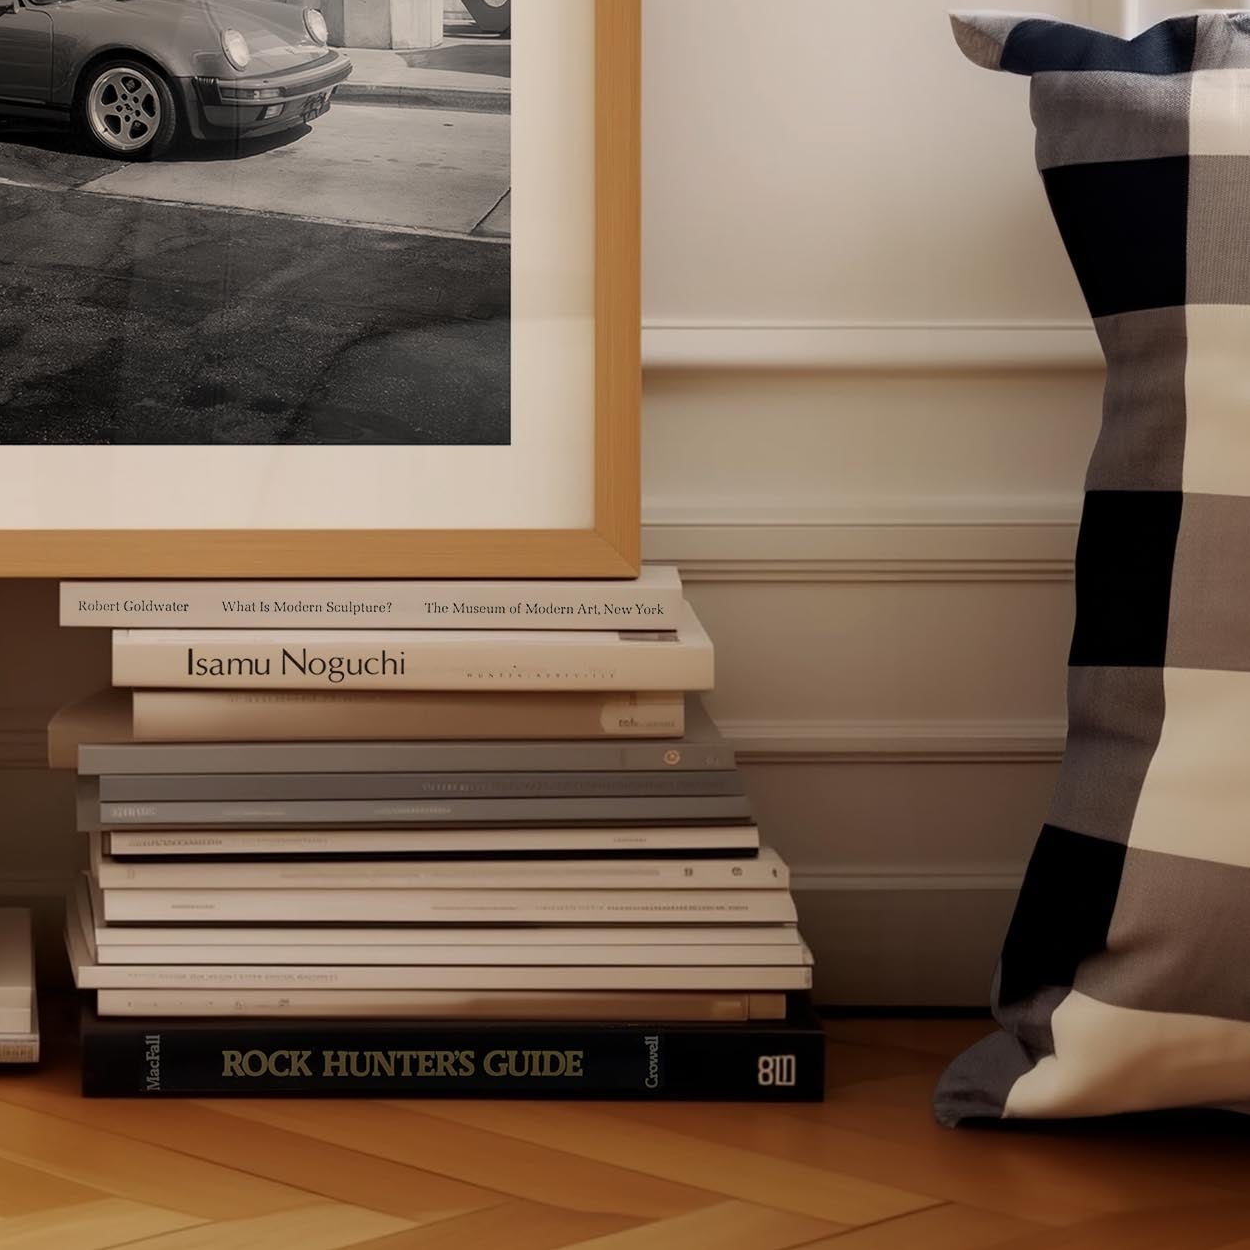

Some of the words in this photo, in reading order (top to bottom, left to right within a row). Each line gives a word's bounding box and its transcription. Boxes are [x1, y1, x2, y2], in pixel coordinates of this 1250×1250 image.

[78, 600, 119, 612] Robert
[123, 600, 190, 612] Goldwater
[222, 600, 255, 612] What
[260, 601, 270, 612] Is
[274, 601, 322, 612] Modern
[327, 601, 392, 616] Sculpture?
[425, 602, 448, 614] The
[453, 603, 506, 614] Museum
[509, 603, 522, 614] of
[526, 603, 573, 614] Modern
[577, 603, 601, 616] Art,
[604, 604, 632, 615] New
[635, 603, 664, 615] York
[188, 648, 270, 676] Isamu
[282, 648, 405, 683] Noguchi
[145, 1034, 161, 1091] MacFall
[221, 1050, 312, 1077] ROCK
[322, 1050, 475, 1077] HUNTER'S
[483, 1050, 584, 1077] GUIDE
[644, 1035, 659, 1089] Crowell
